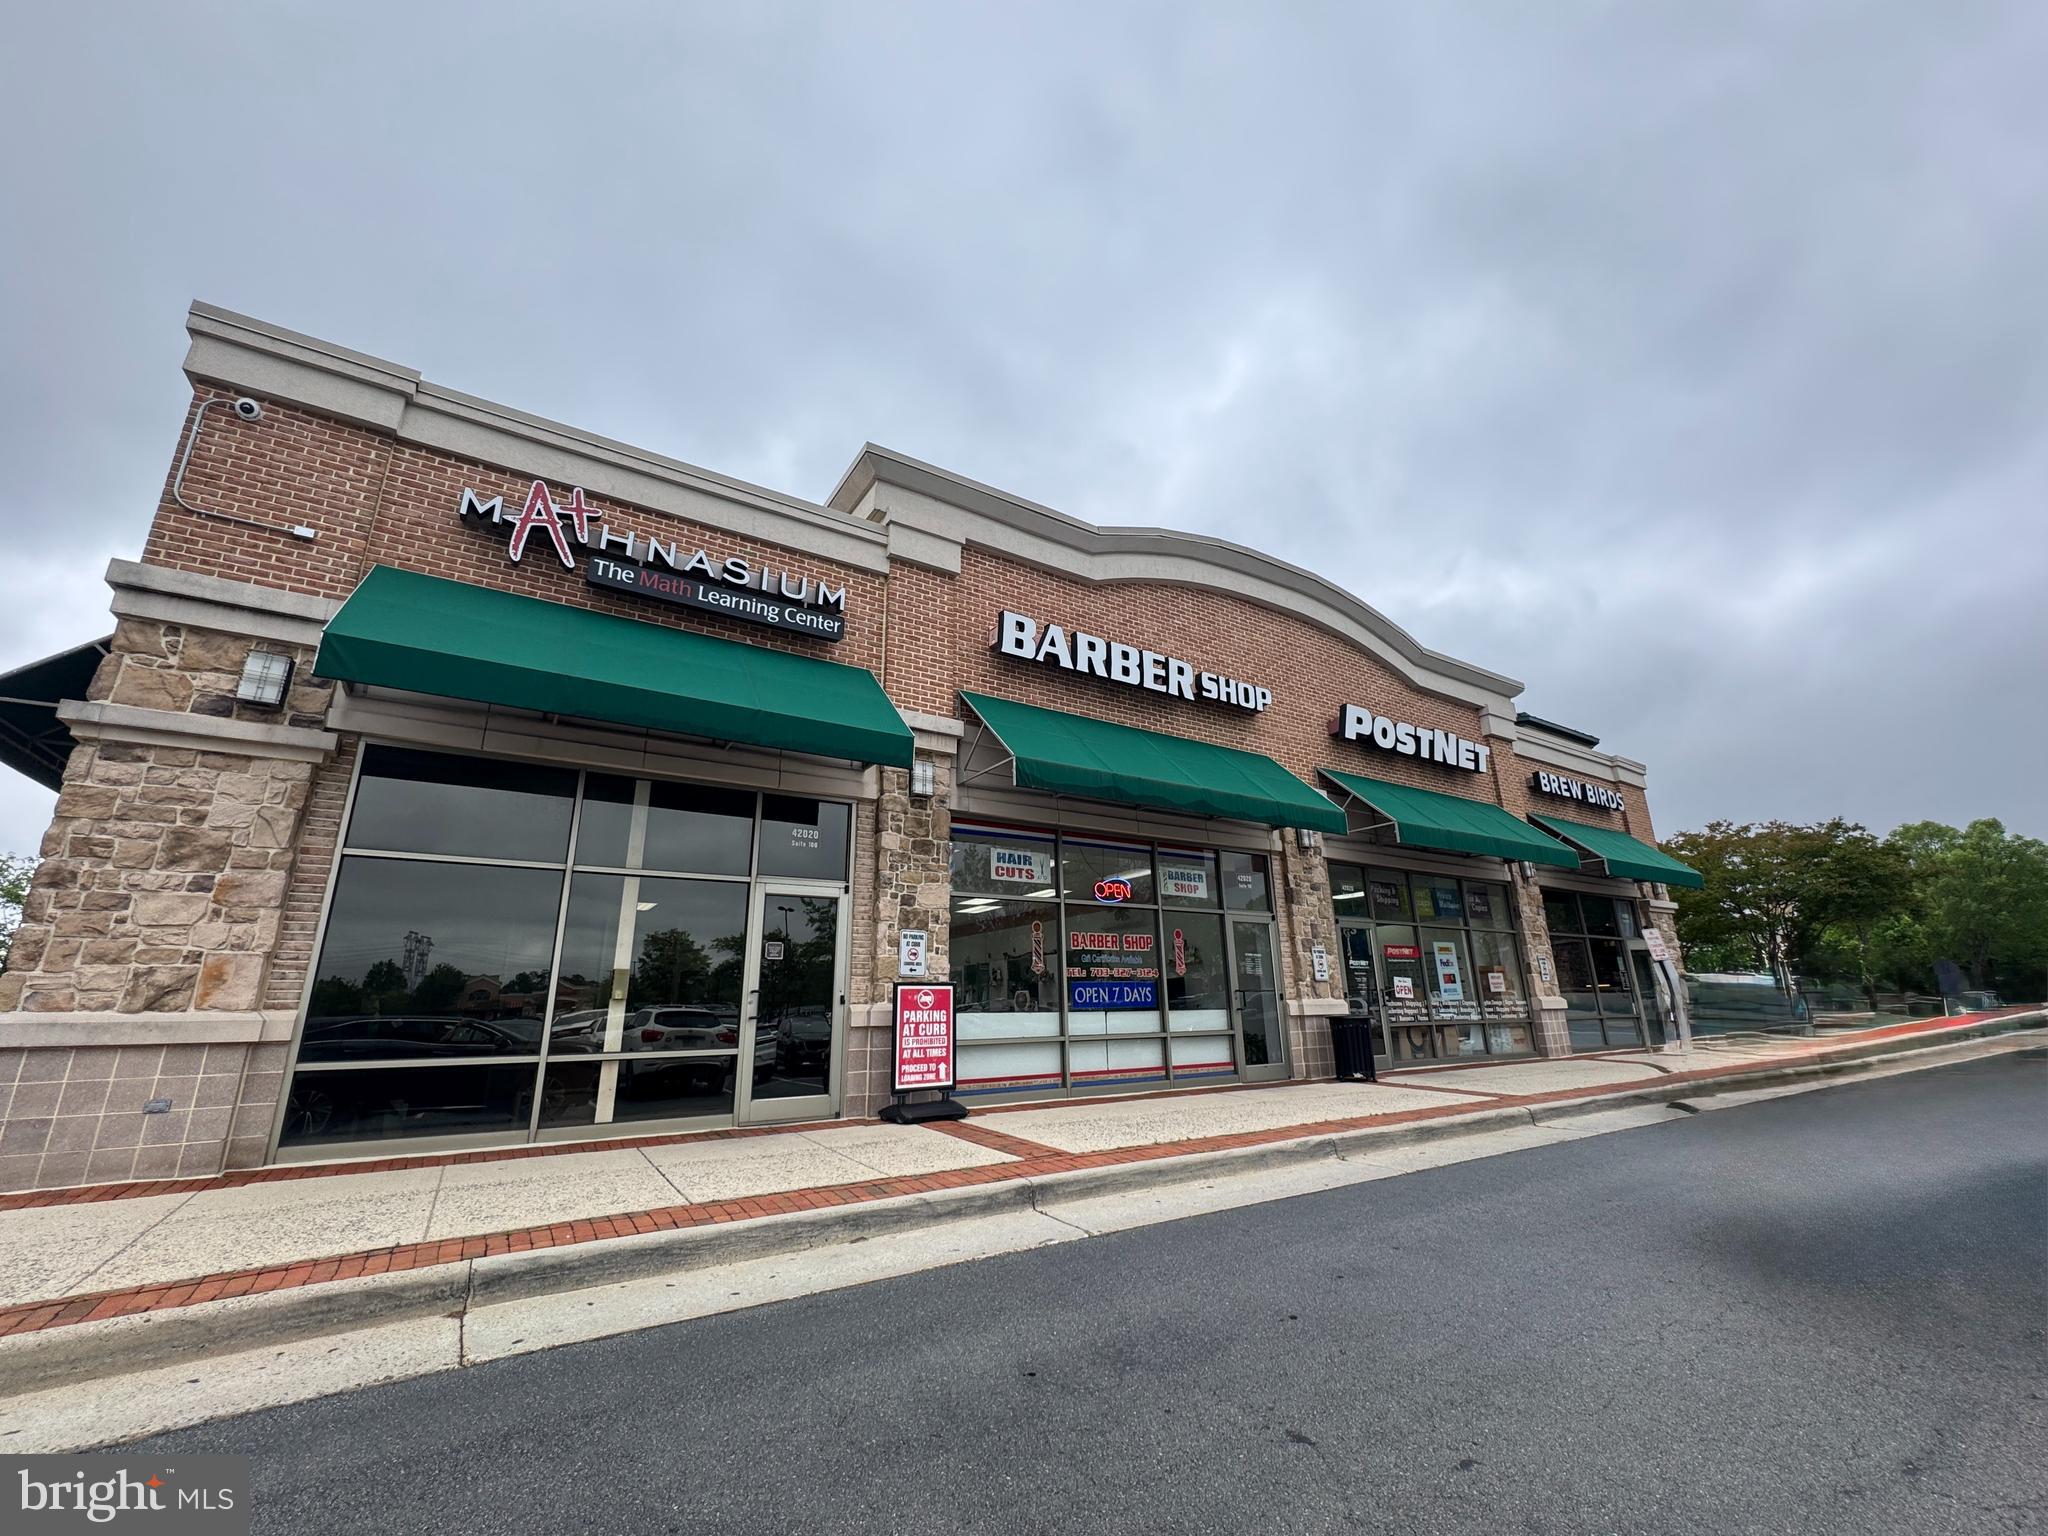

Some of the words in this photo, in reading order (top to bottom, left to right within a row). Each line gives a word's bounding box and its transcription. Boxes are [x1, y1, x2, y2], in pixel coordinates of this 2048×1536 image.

[594, 558, 635, 583] The
[639, 570, 692, 598] Math
[698, 586, 780, 623] Learning
[784, 606, 842, 634] Center
[1001, 610, 1196, 701] BARBER
[1201, 671, 1273, 712] SHOP
[1539, 771, 1582, 800] BREW
[1586, 782, 1625, 812] BIRDS
[792, 829, 819, 839] 42020
[996, 852, 1033, 866] HAIR
[995, 866, 1035, 880] CUTS
[1167, 870, 1205, 883] BARBER
[1094, 881, 1131, 899] OPEN
[1174, 883, 1200, 894] SHOP
[1071, 932, 1119, 950] BARBER
[1123, 934, 1153, 951] SHOP
[1440, 959, 1454, 967] FedEx
[1075, 987, 1108, 1002] OPEN
[1112, 987, 1120, 1001] 7
[1124, 987, 1152, 1002] DAYS
[1395, 985, 1412, 995] OPEN
[903, 1010, 947, 1023] PARKING
[903, 1024, 915, 1036] AT
[919, 1023, 947, 1036] CURB
[904, 1038, 910, 1046] IS
[912, 1037, 946, 1046] PROHIBITED
[903, 1049, 911, 1058] AT
[912, 1049, 925, 1058] ALL
[926, 1048, 947, 1057] TIMES
[901, 1064, 928, 1073] PROCEED
[929, 1063, 937, 1071] TO
